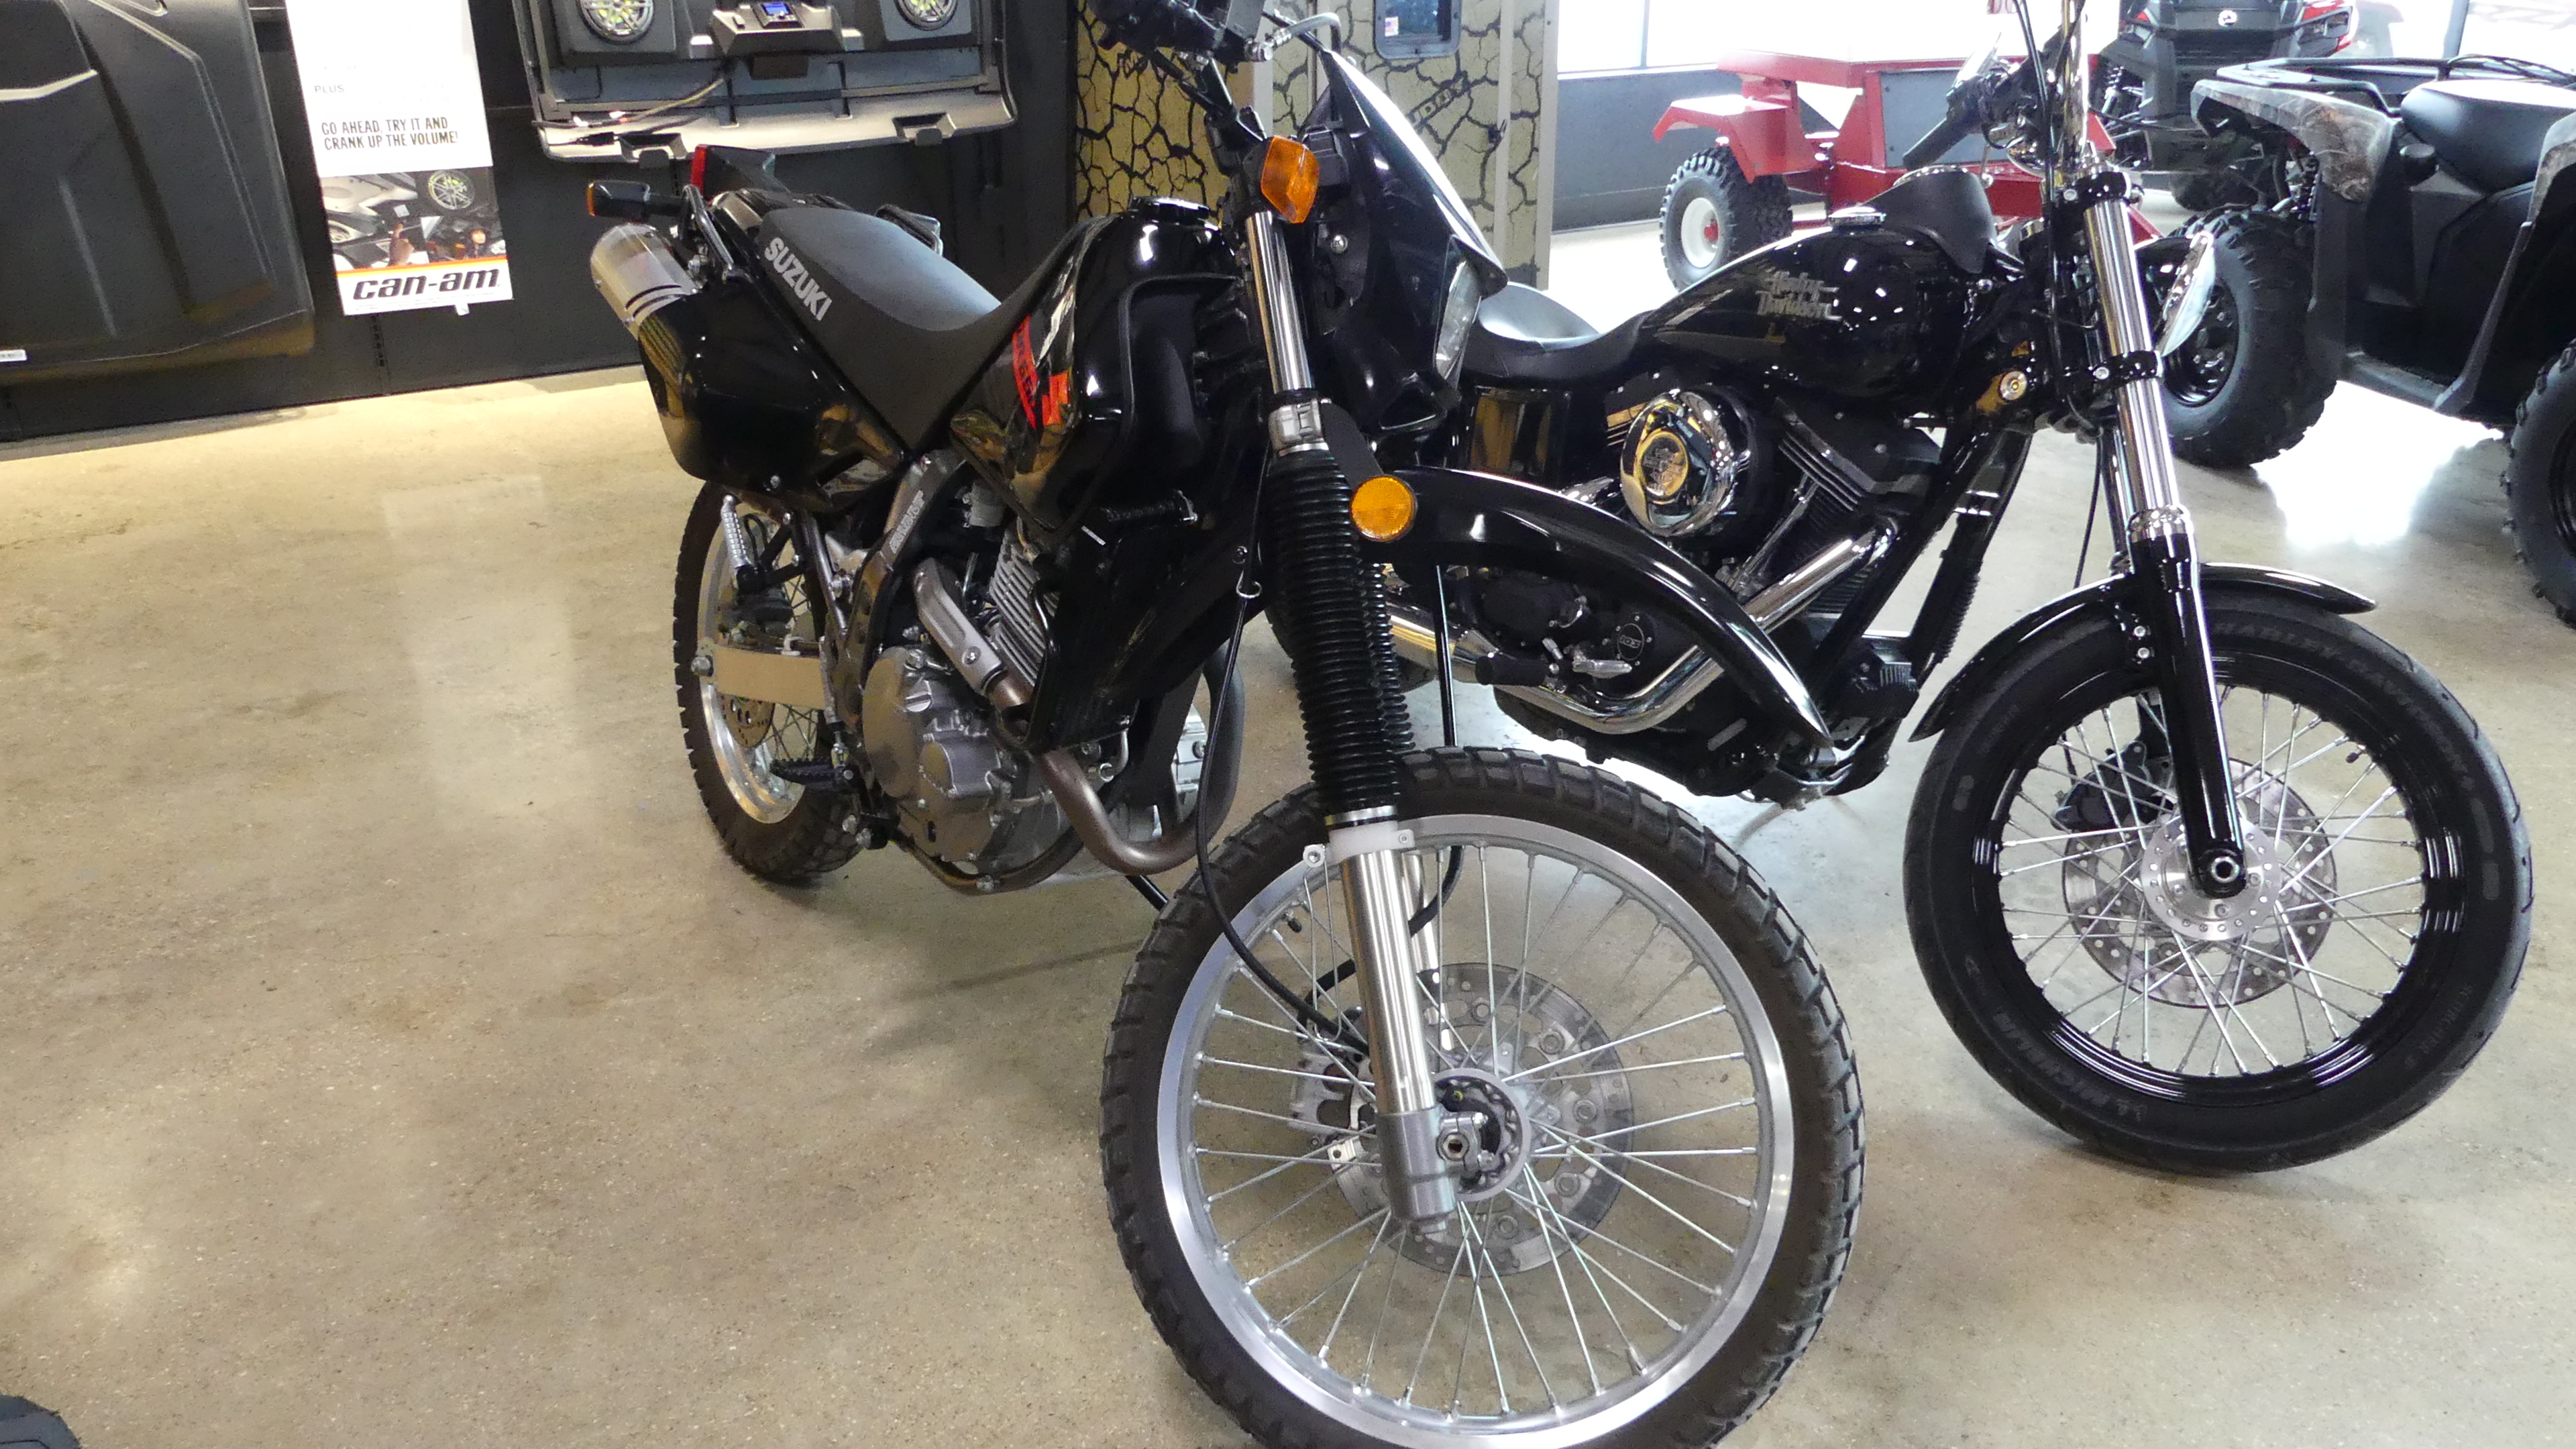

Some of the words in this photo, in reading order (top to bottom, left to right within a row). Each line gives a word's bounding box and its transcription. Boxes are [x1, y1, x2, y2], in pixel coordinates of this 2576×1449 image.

[315, 85, 344, 93] PLUS
[321, 122, 337, 135] GO
[386, 119, 406, 131] TRY
[411, 118, 420, 130] IT
[425, 117, 448, 129] AND
[324, 136, 364, 150] CRANK
[368, 135, 382, 148] UP
[386, 133, 407, 146] THE
[410, 131, 458, 145] VOLUME!
[353, 268, 499, 300] can-am
[765, 237, 832, 321] SUZUKI
